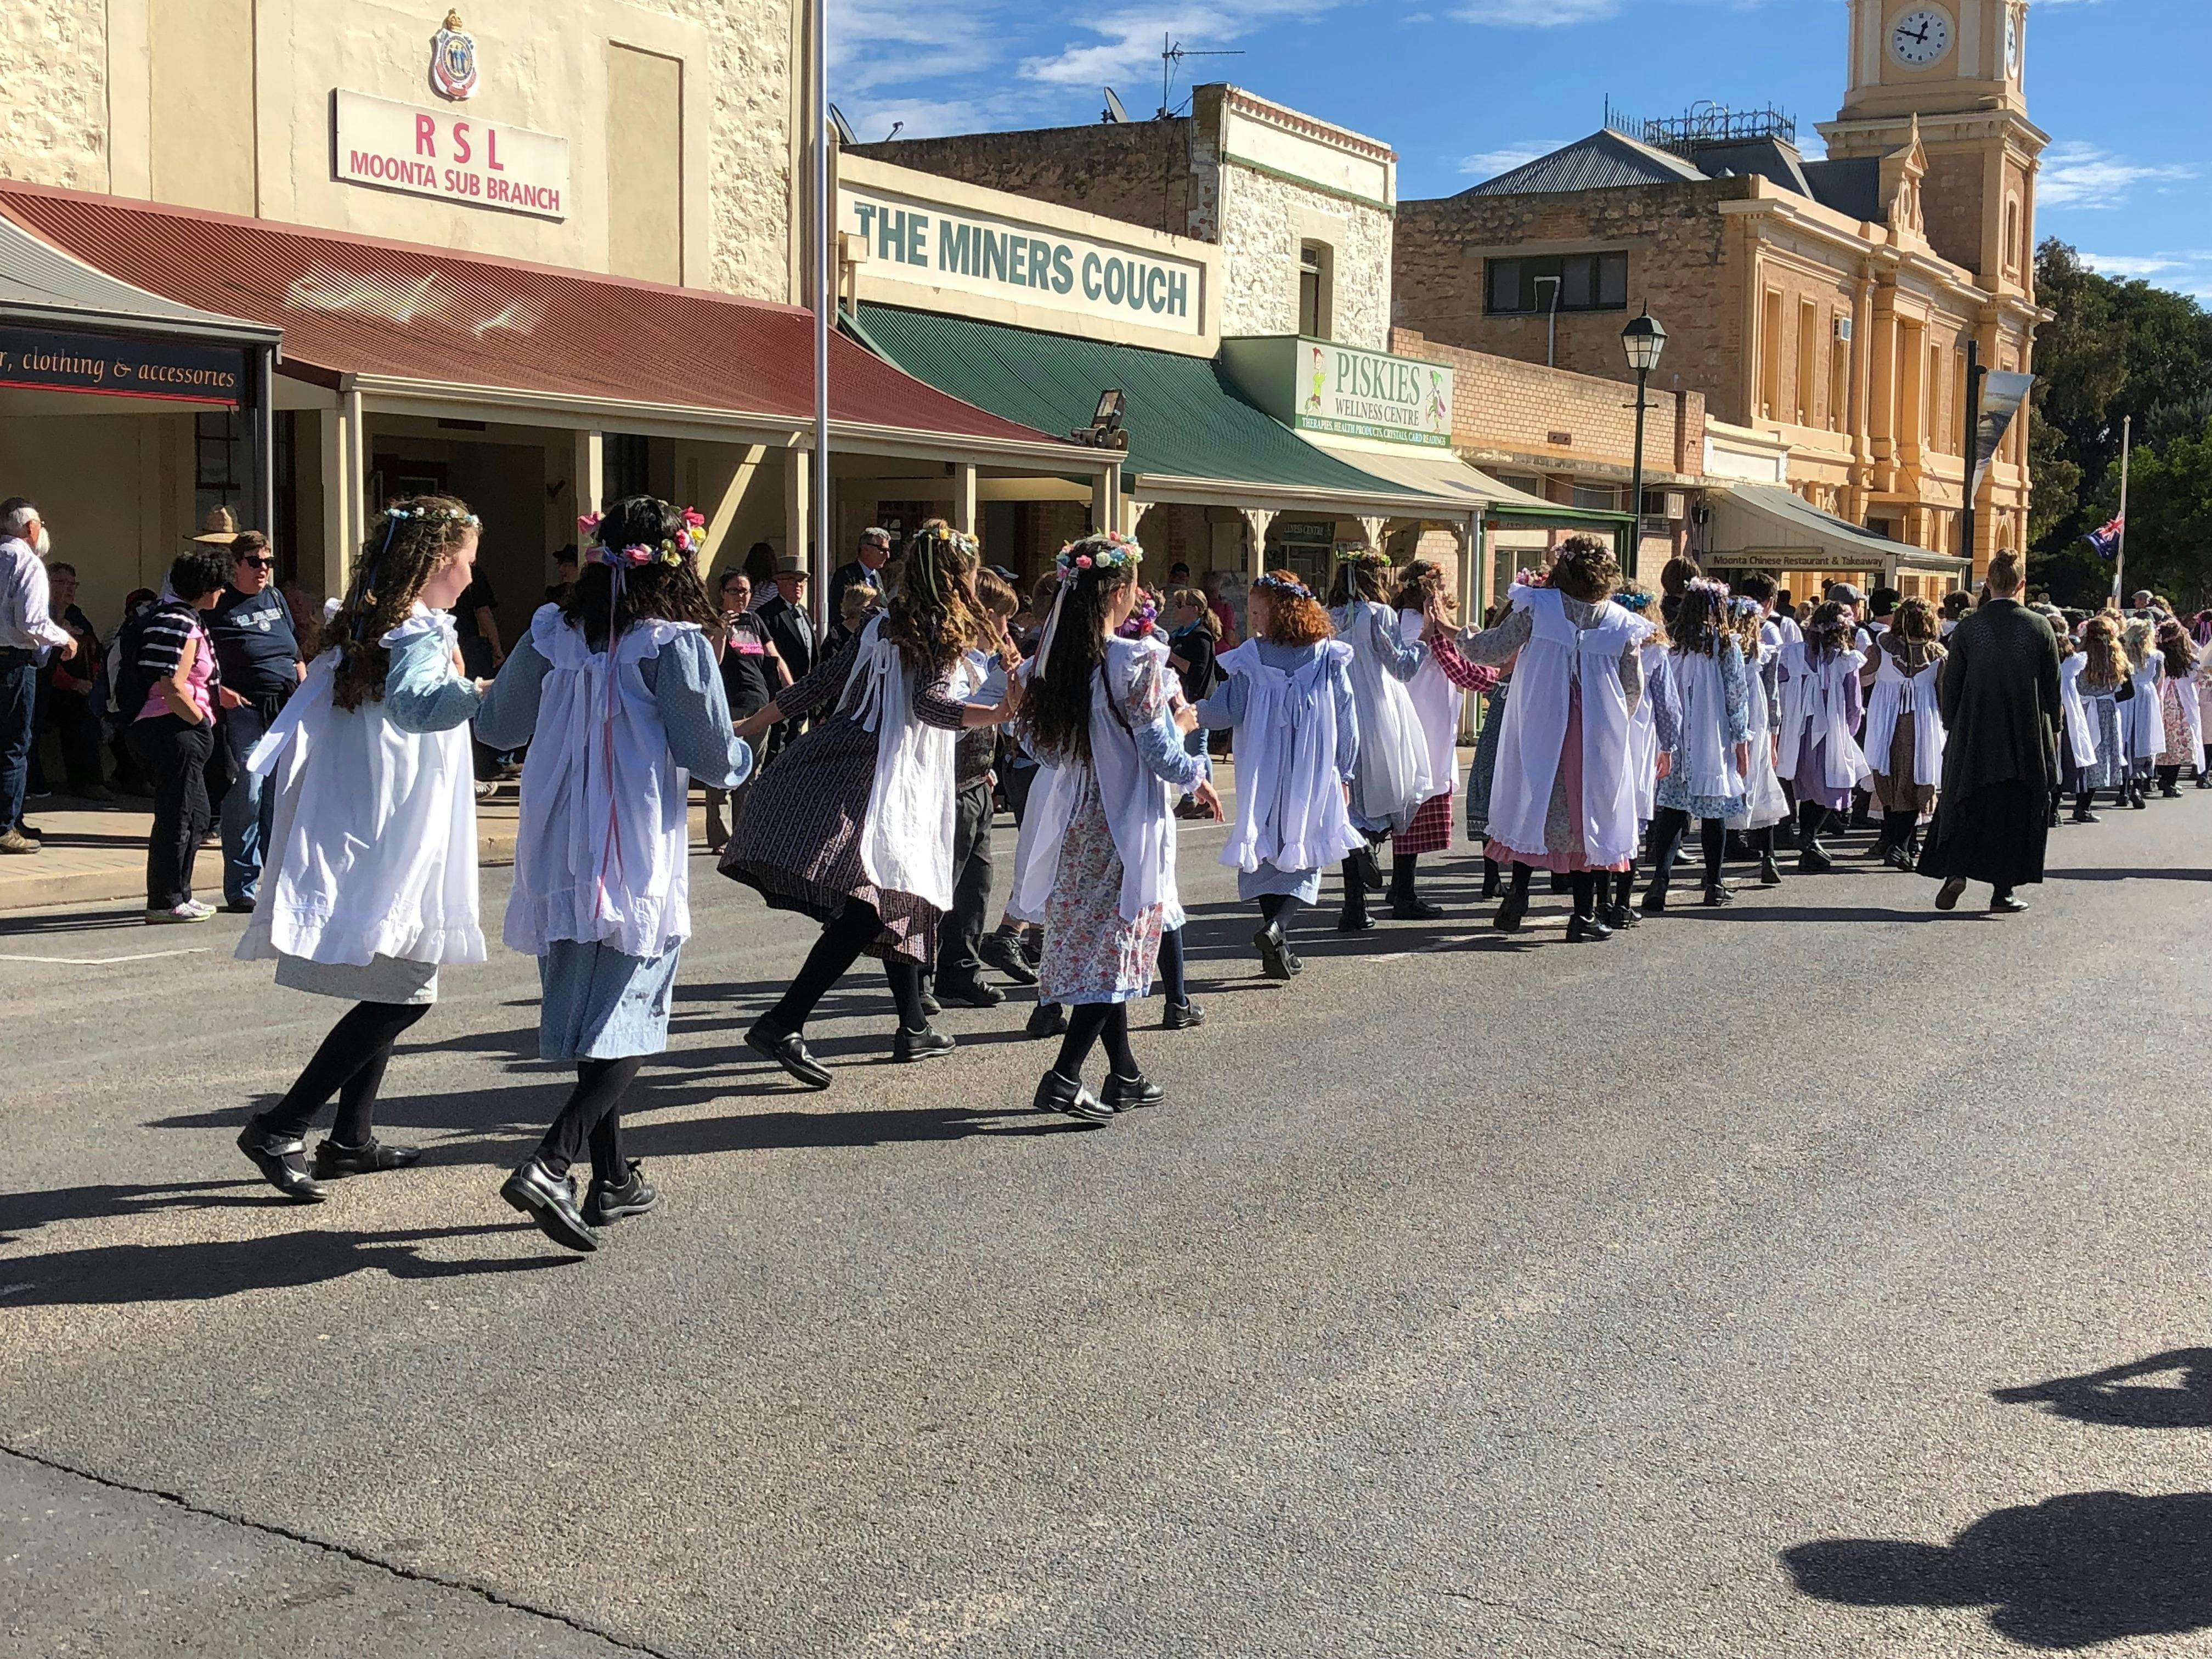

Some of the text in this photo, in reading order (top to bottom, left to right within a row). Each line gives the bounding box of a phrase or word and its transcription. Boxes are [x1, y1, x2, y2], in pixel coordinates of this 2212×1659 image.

[350, 150, 560, 212] MOONTA SUB BRANCH
[854, 201, 1187, 317] THE MINERS COUCH
[22, 346, 104, 383] clothing
[114, 357, 132, 377] &
[138, 362, 235, 387] accessories
[1335, 351, 1420, 406] PISKIES
[1334, 421, 1355, 434] HEALTH
[1408, 432, 1423, 442] CARD
[1335, 398, 1420, 426] WELLNESS CENTRE
[1714, 555, 1883, 567] Moonta Chinese Restaurant & Takeaway
